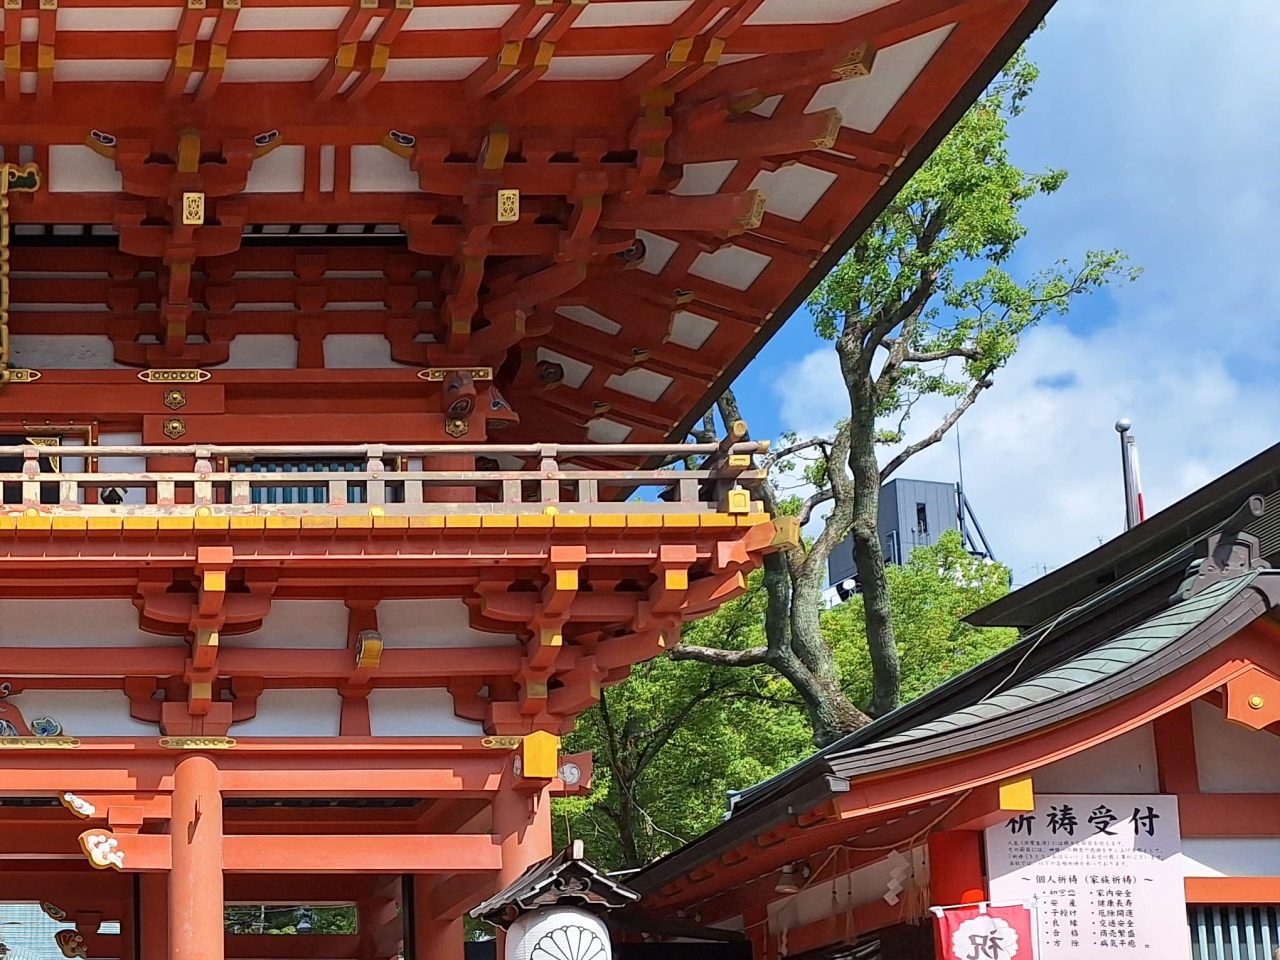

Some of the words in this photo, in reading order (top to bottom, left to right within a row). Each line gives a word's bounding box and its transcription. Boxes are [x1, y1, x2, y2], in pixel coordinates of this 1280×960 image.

[1005, 805, 1160, 837] 祈祷受付
[1097, 889, 1132, 898] 家内安全
[1097, 899, 1133, 908] 健康長寿
[1099, 919, 1135, 928] 交通安全
